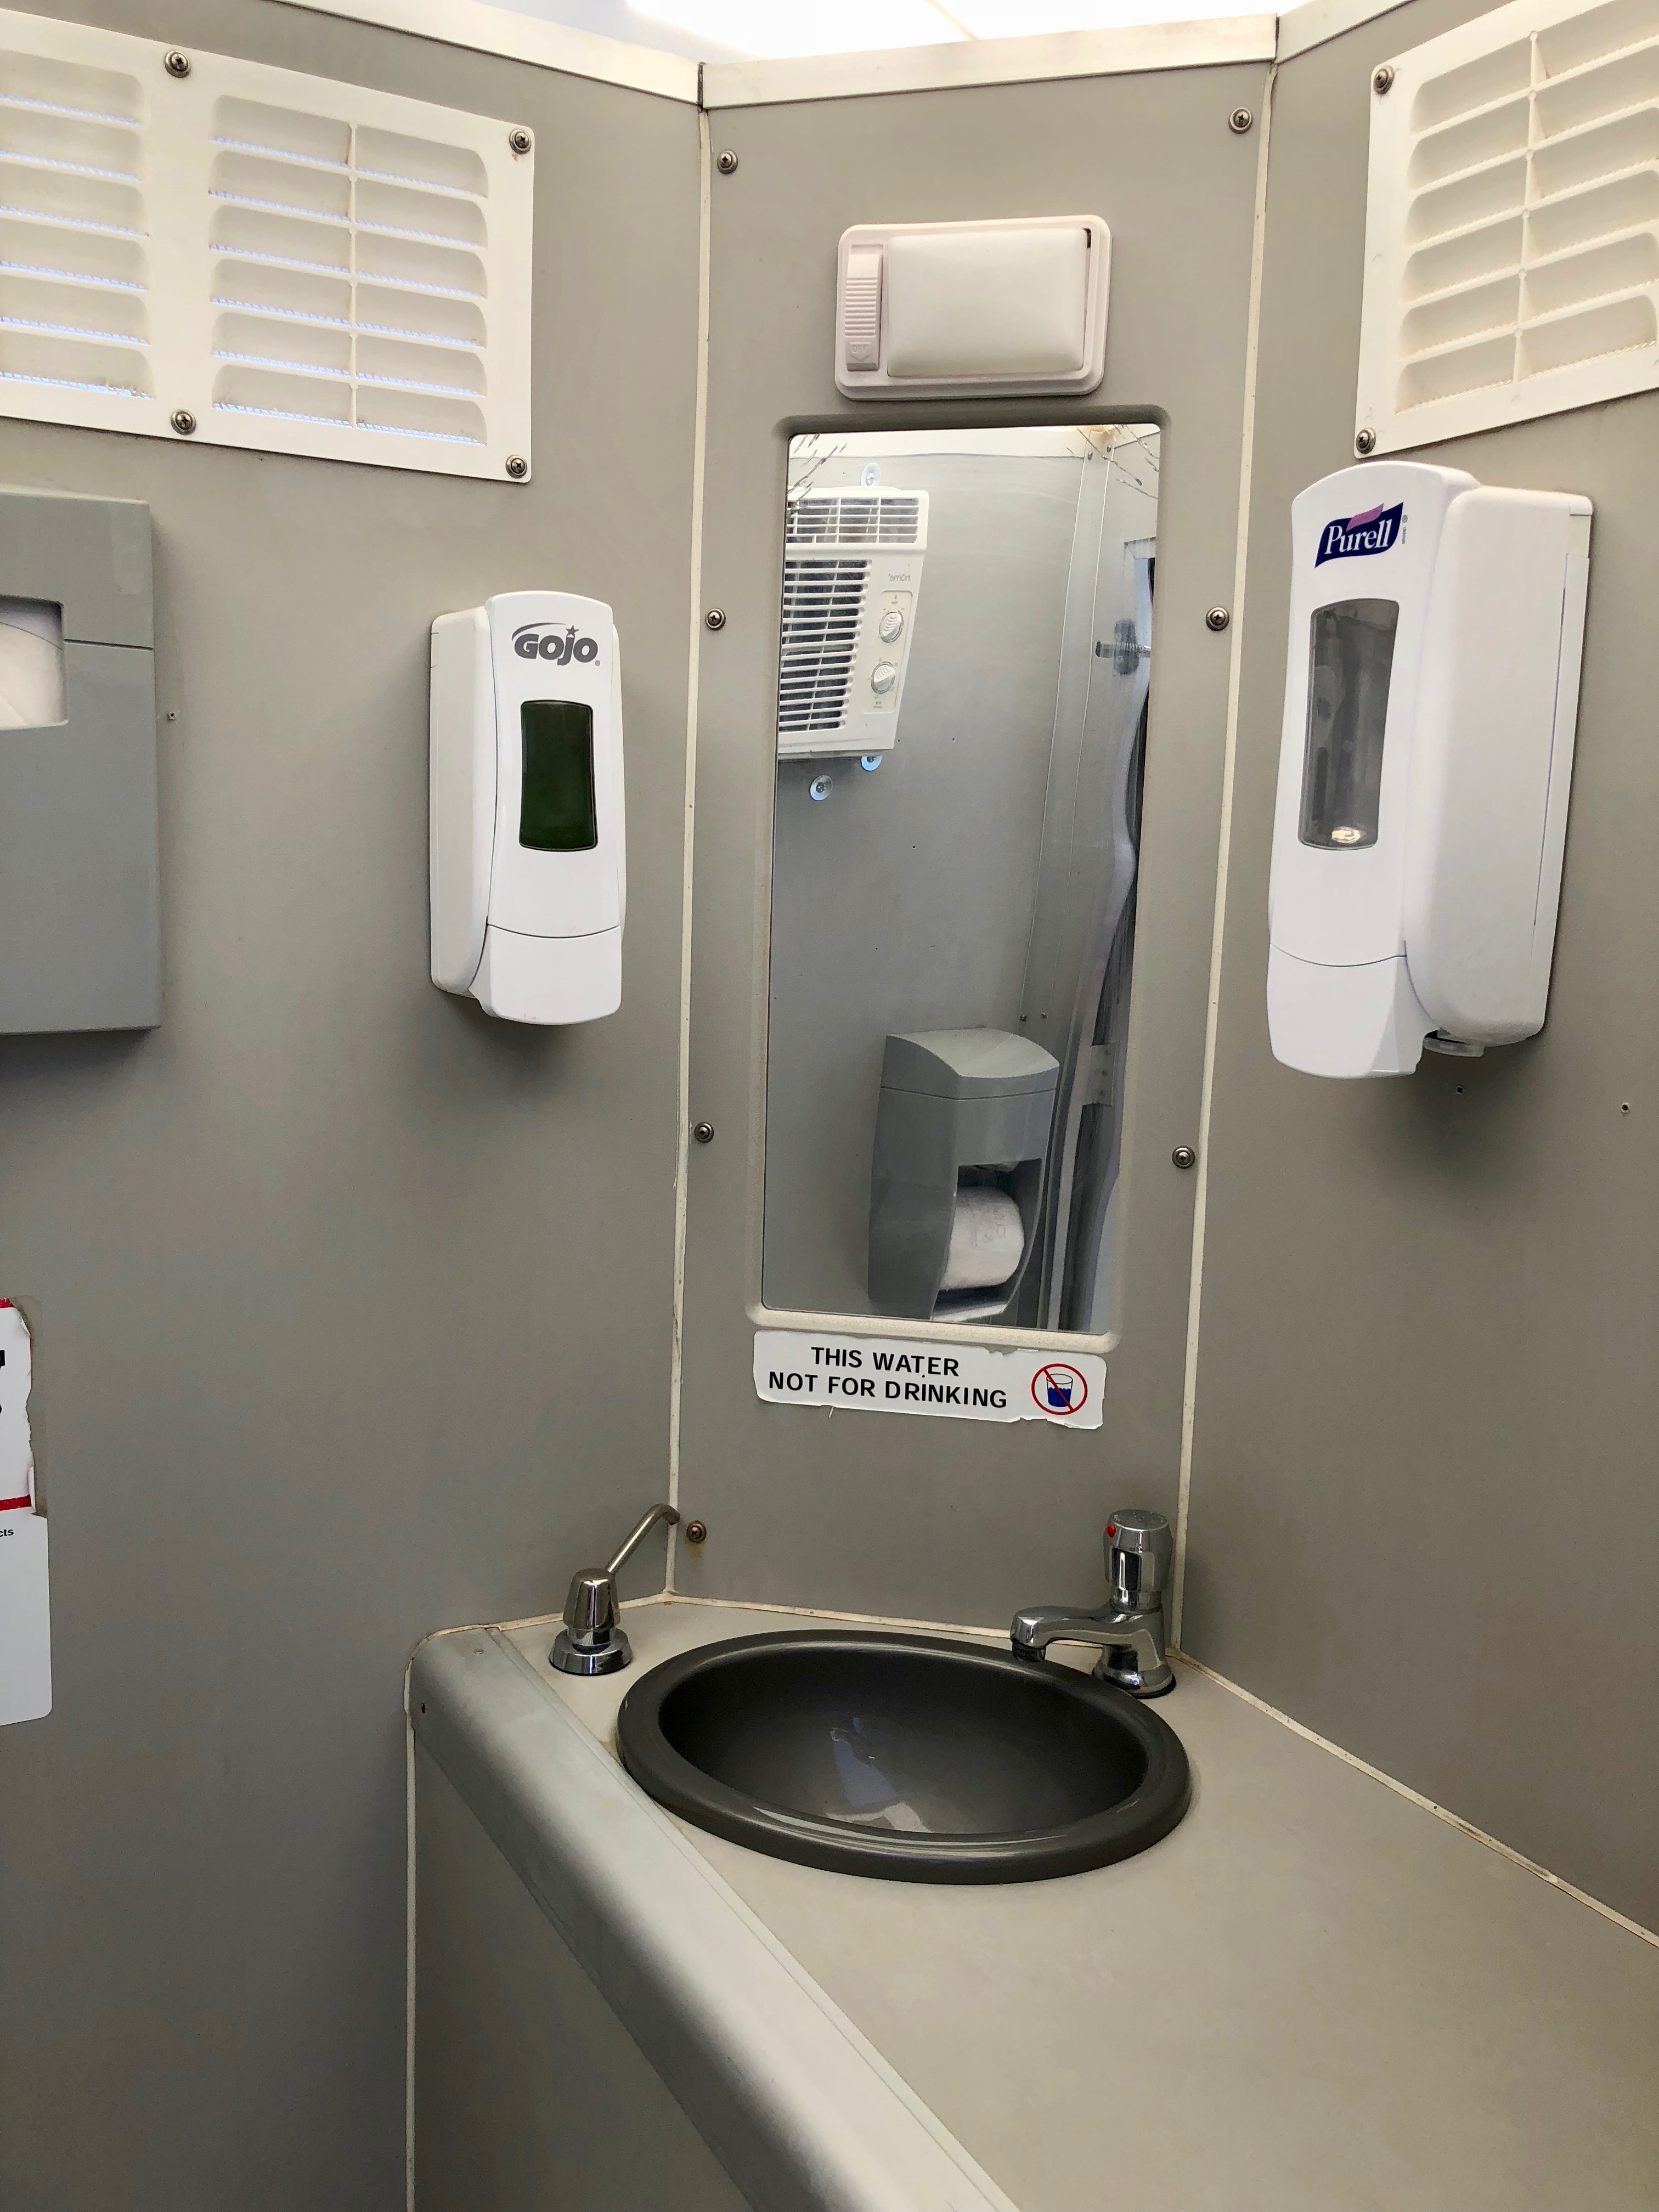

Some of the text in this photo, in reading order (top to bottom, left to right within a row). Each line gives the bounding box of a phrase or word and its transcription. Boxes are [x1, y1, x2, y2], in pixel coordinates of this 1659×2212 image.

[1324, 518, 1393, 555] Purell
[811, 1346, 960, 1376] THIS WATER
[769, 1371, 1007, 1408] NOT FOR DRINKING
